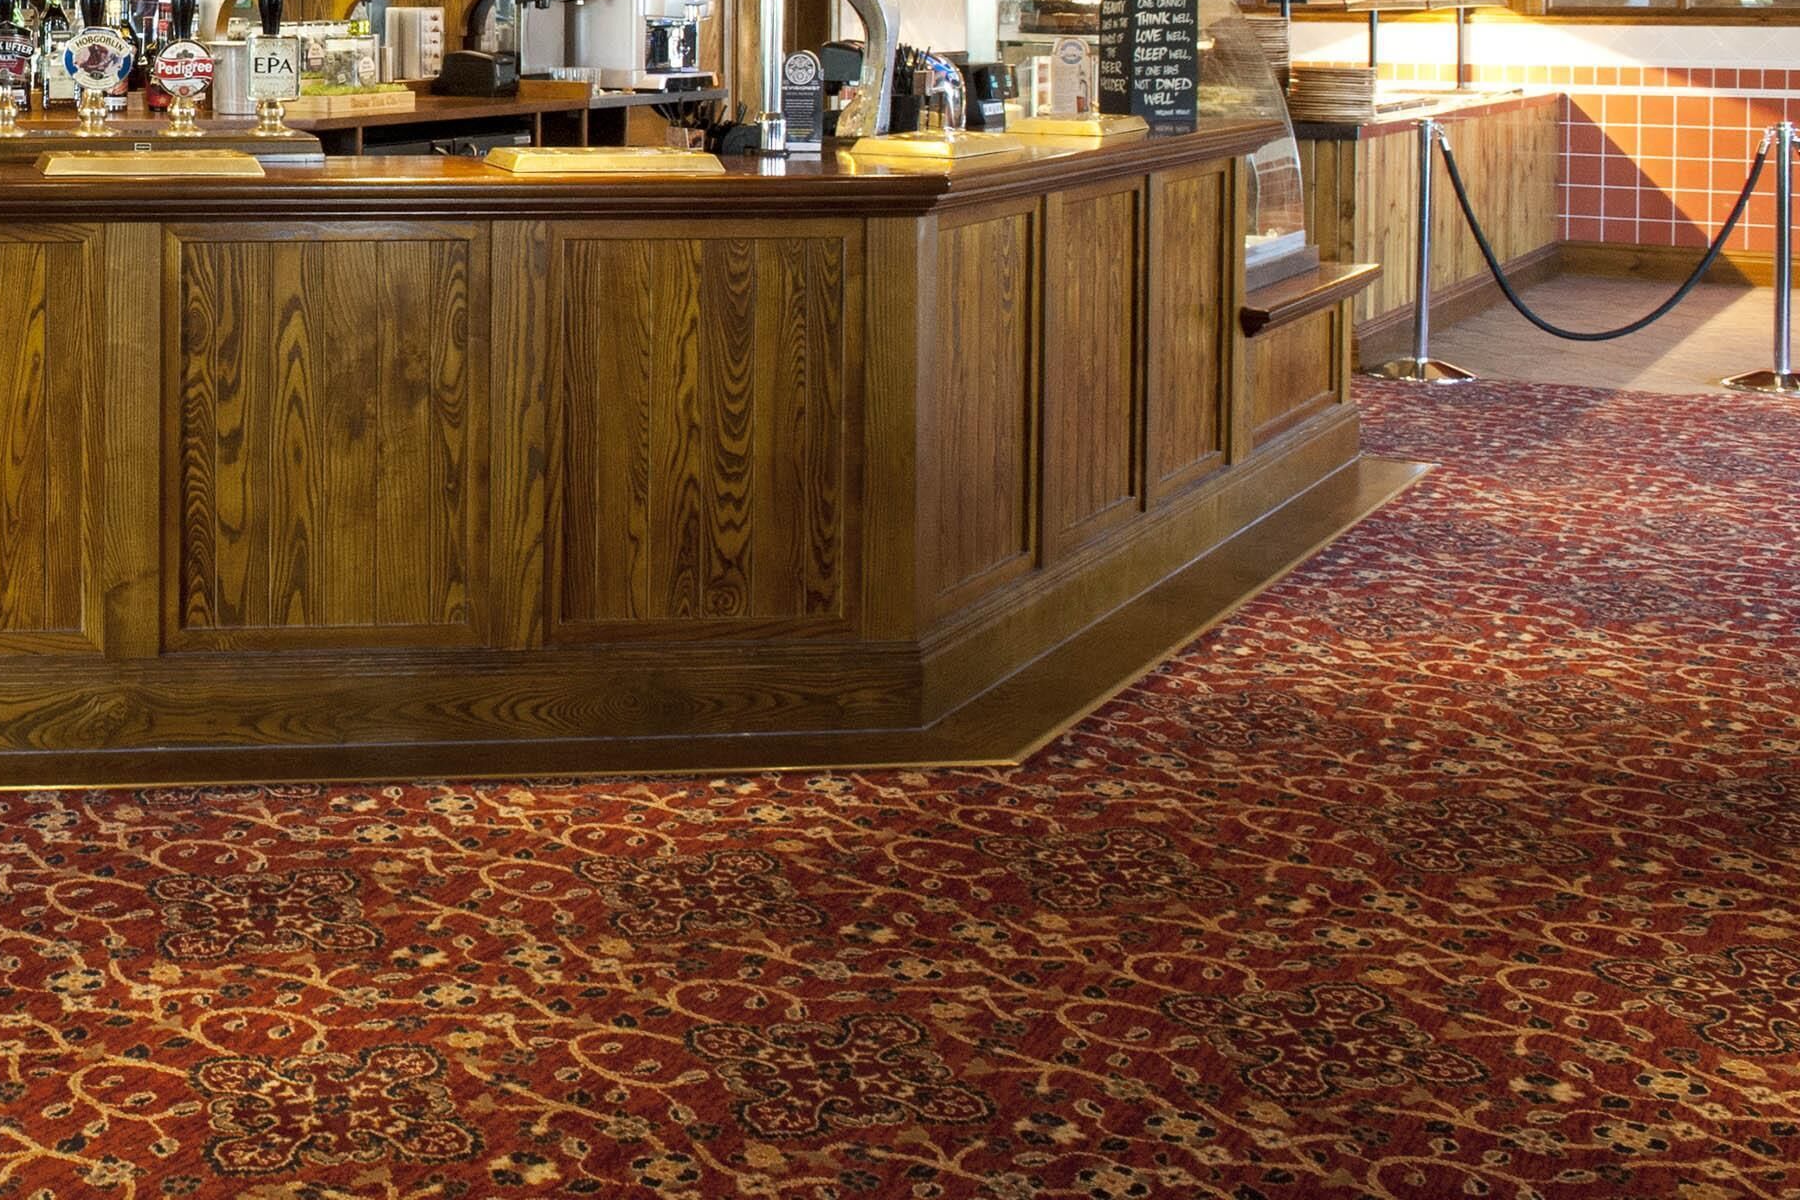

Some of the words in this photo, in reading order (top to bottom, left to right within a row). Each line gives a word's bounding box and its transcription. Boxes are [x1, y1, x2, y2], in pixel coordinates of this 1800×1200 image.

[1135, 11, 1170, 27] THINK
[1172, 13, 1194, 26] WELL,
[75, 35, 125, 52] HOBGOBLIN
[1135, 28, 1163, 43] LOVE
[1166, 31, 1191, 43] WELL,
[6, 39, 34, 56] LIFTER
[1134, 46, 1168, 62] SLEEP
[1168, 49, 1193, 61] WELL,
[157, 59, 213, 78] Pedigree
[254, 56, 294, 74] EPA
[1134, 65, 1143, 76] IF
[1145, 65, 1162, 76] ONE
[1163, 64, 1180, 76] HAS
[1134, 79, 1152, 91] NOT
[1155, 78, 1193, 91] DINED
